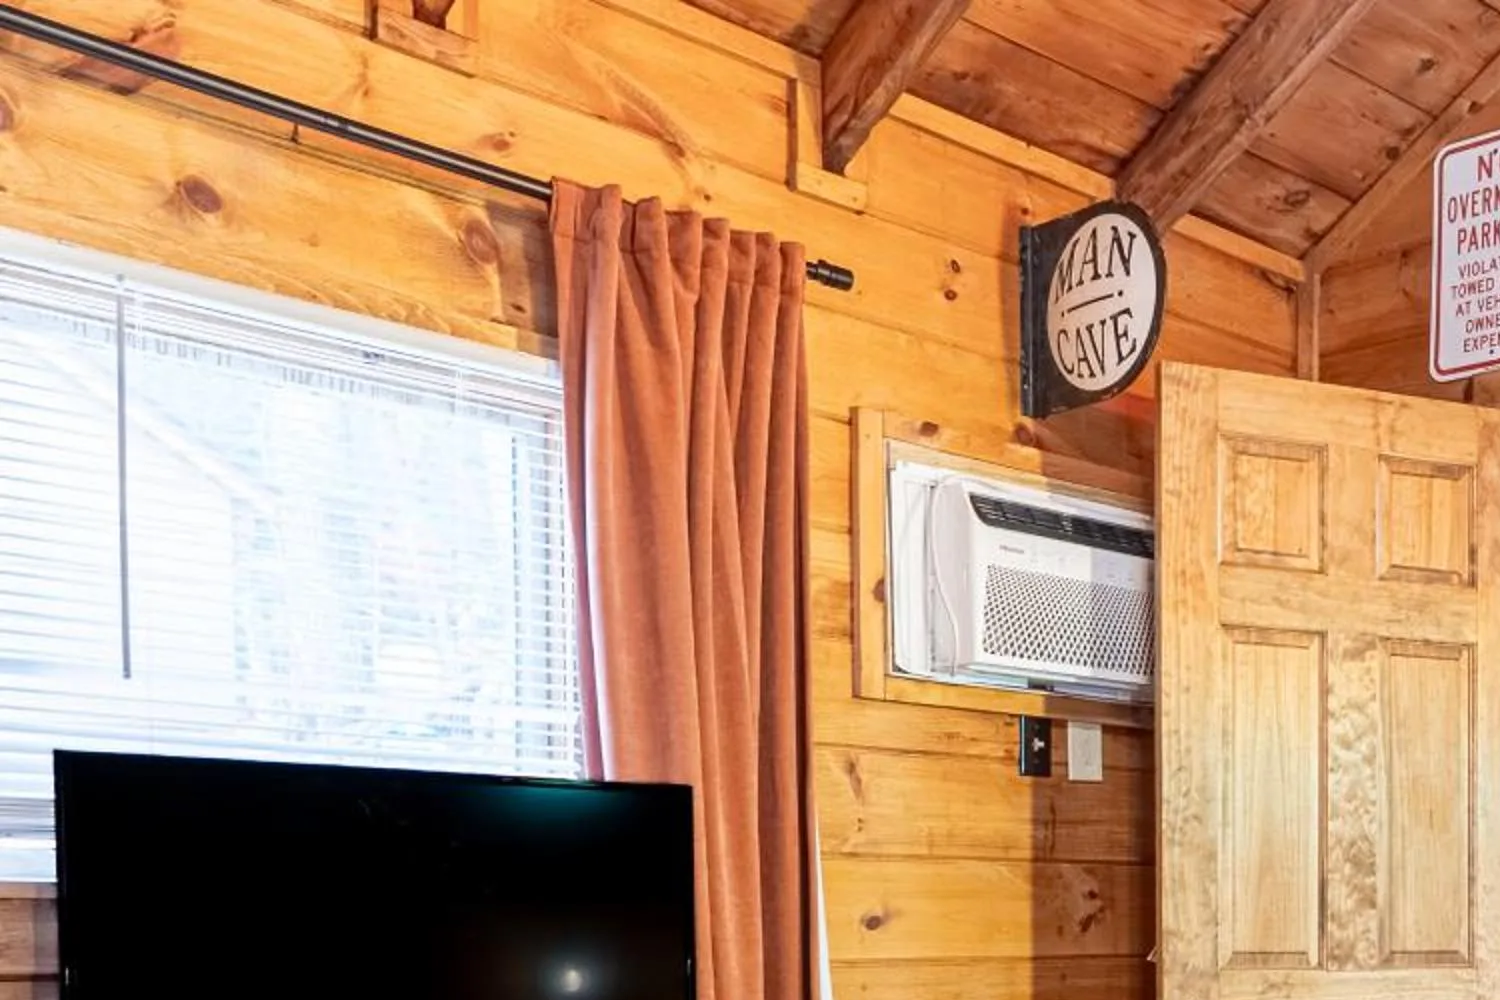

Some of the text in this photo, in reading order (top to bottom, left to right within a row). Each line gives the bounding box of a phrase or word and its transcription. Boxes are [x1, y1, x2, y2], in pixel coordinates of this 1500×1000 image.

[1055, 225, 1137, 304] MAN
[1450, 278, 1495, 299] TOWED
[1455, 301, 1472, 317] AT
[1056, 307, 1137, 379] CAVE
